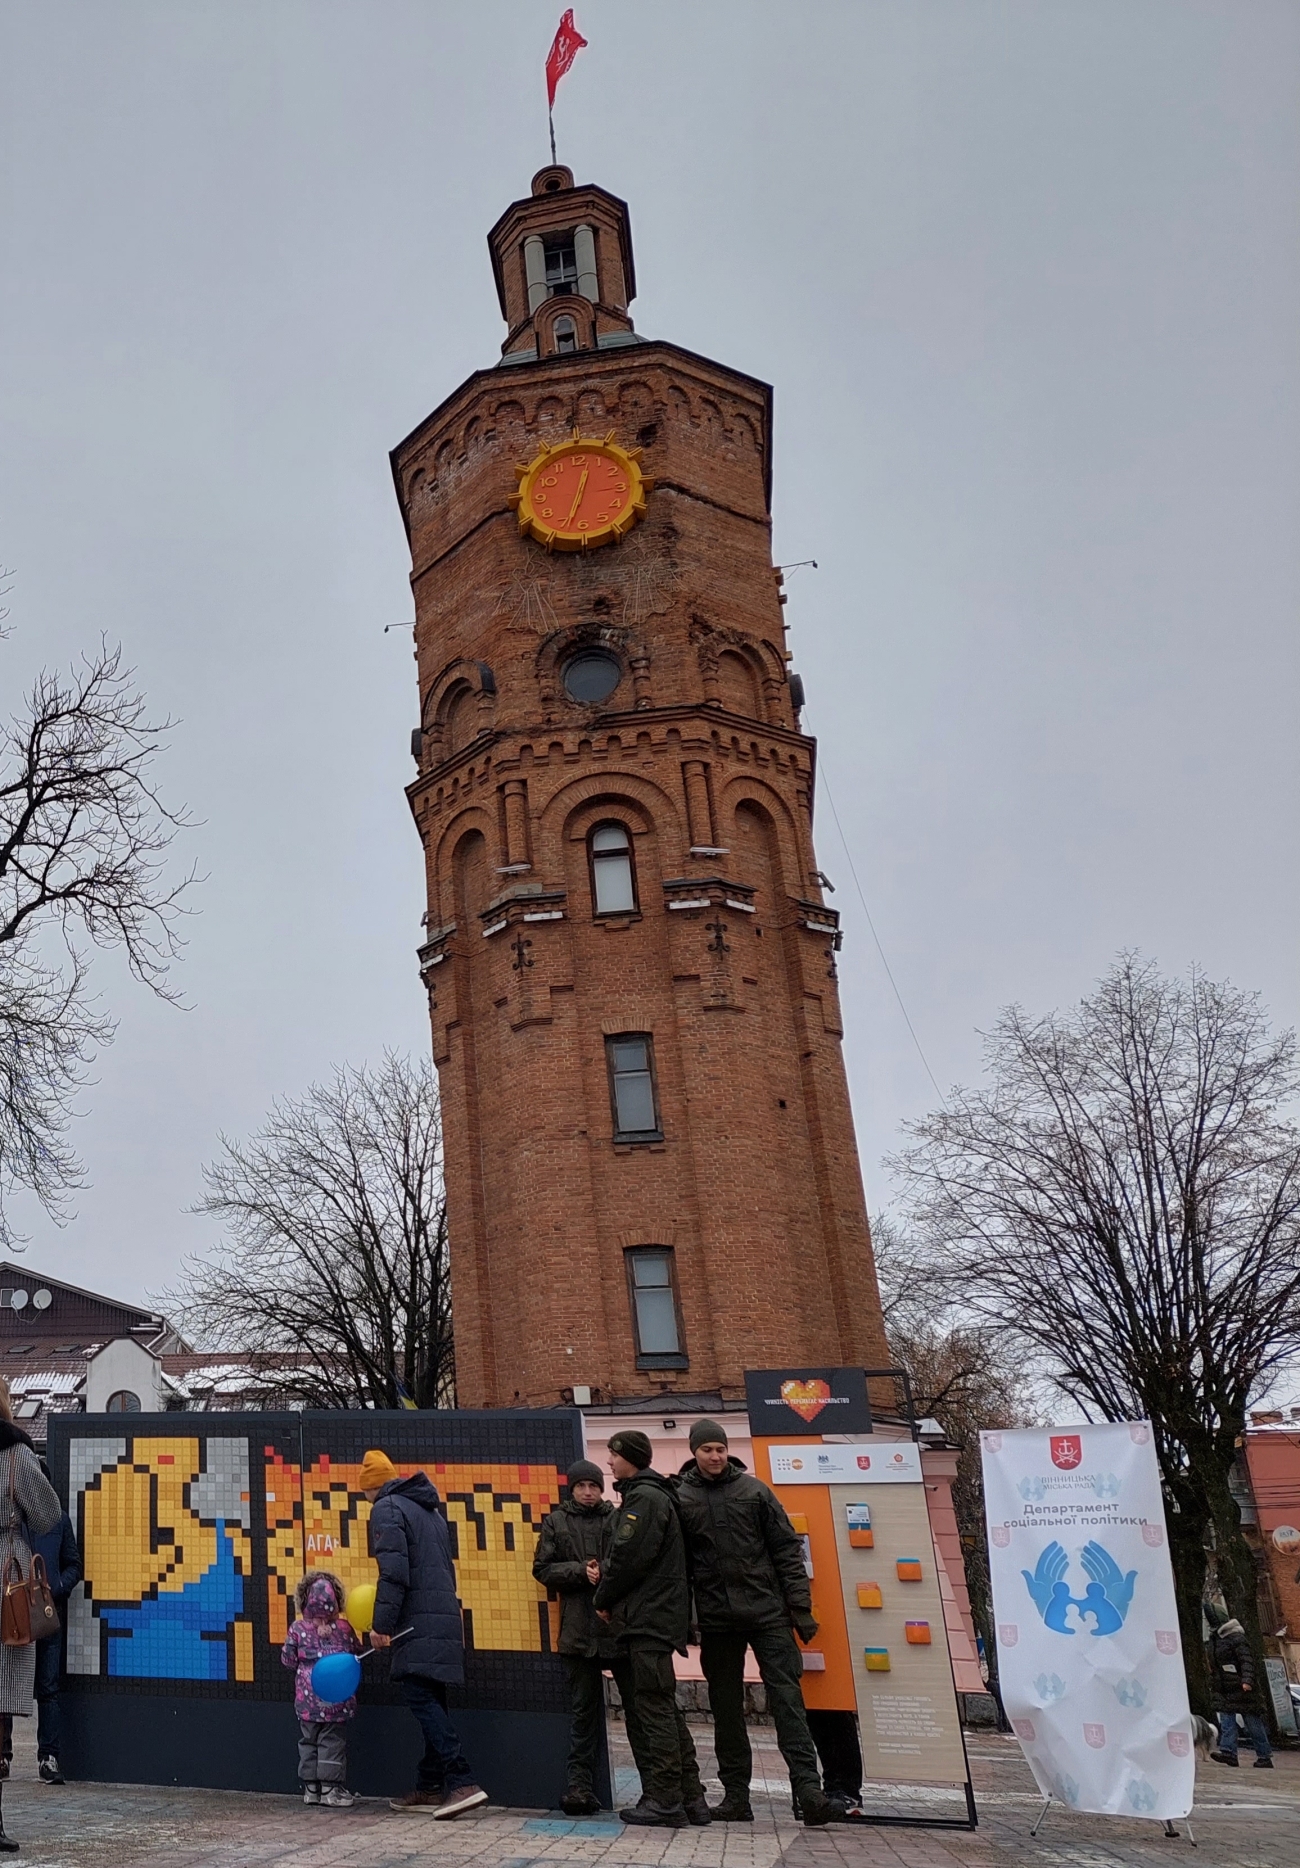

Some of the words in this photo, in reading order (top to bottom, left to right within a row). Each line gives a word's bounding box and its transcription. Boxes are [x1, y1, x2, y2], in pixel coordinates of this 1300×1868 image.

[570, 455, 586, 467] 12
[595, 456, 601, 467] 1
[554, 463, 564, 474] 11
[607, 466, 619, 477] 2
[540, 476, 558, 488] 10
[615, 482, 627, 492] 3
[535, 493, 547, 503] 9
[608, 498, 622, 509] 4
[542, 508, 554, 518] 8
[596, 511, 609, 523] 5
[557, 517, 569, 528] 7
[577, 519, 589, 530] 6
[1041, 1475, 1096, 1484] ВІННИЦЬКА
[1023, 1503, 1120, 1516] Департамент
[1003, 1515, 1077, 1529] соціальної
[1080, 1514, 1148, 1526] політики
